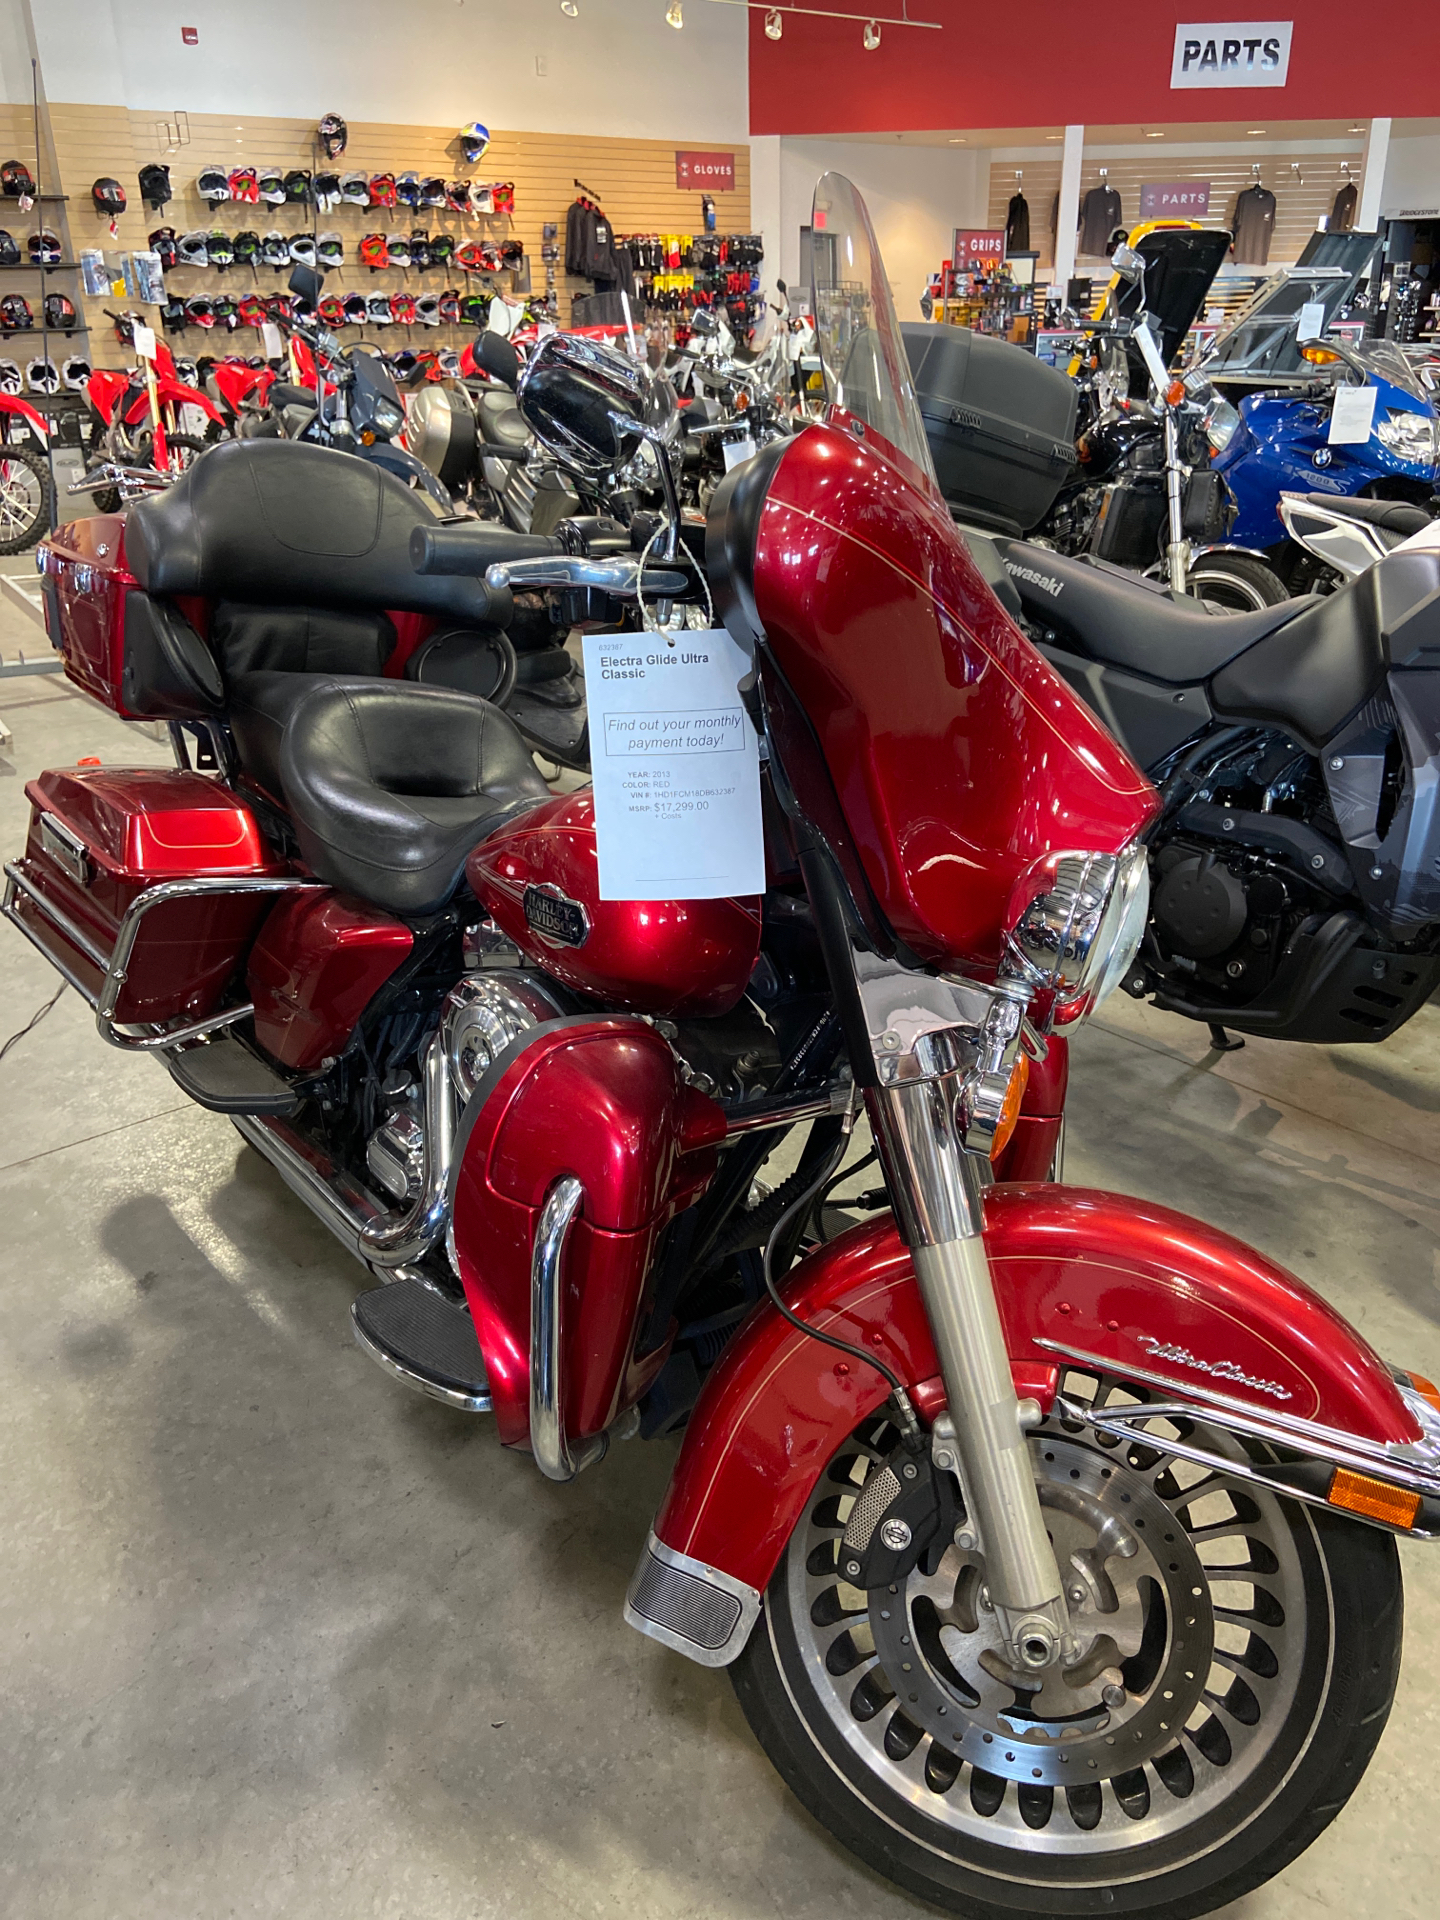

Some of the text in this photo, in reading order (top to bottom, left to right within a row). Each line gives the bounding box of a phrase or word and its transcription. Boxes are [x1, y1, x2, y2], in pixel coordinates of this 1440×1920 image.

[1182, 38, 1280, 72] PARTS
[693, 164, 732, 176] GLOVES
[1162, 193, 1206, 205] PARTS
[970, 238, 1001, 252] GRIPS
[600, 653, 709, 667] Electra Glide Ultra
[601, 668, 646, 680] Classic
[608, 714, 741, 732] Find out your monthly
[628, 733, 724, 751] payment today!
[652, 770, 671, 778] 2013
[653, 780, 671, 788] RED
[654, 801, 709, 813] $17,299.00
[661, 812, 682, 820] Costs
[526, 904, 579, 937] DAVIDSON
[1137, 1335, 1293, 1400] Ultra Classic
